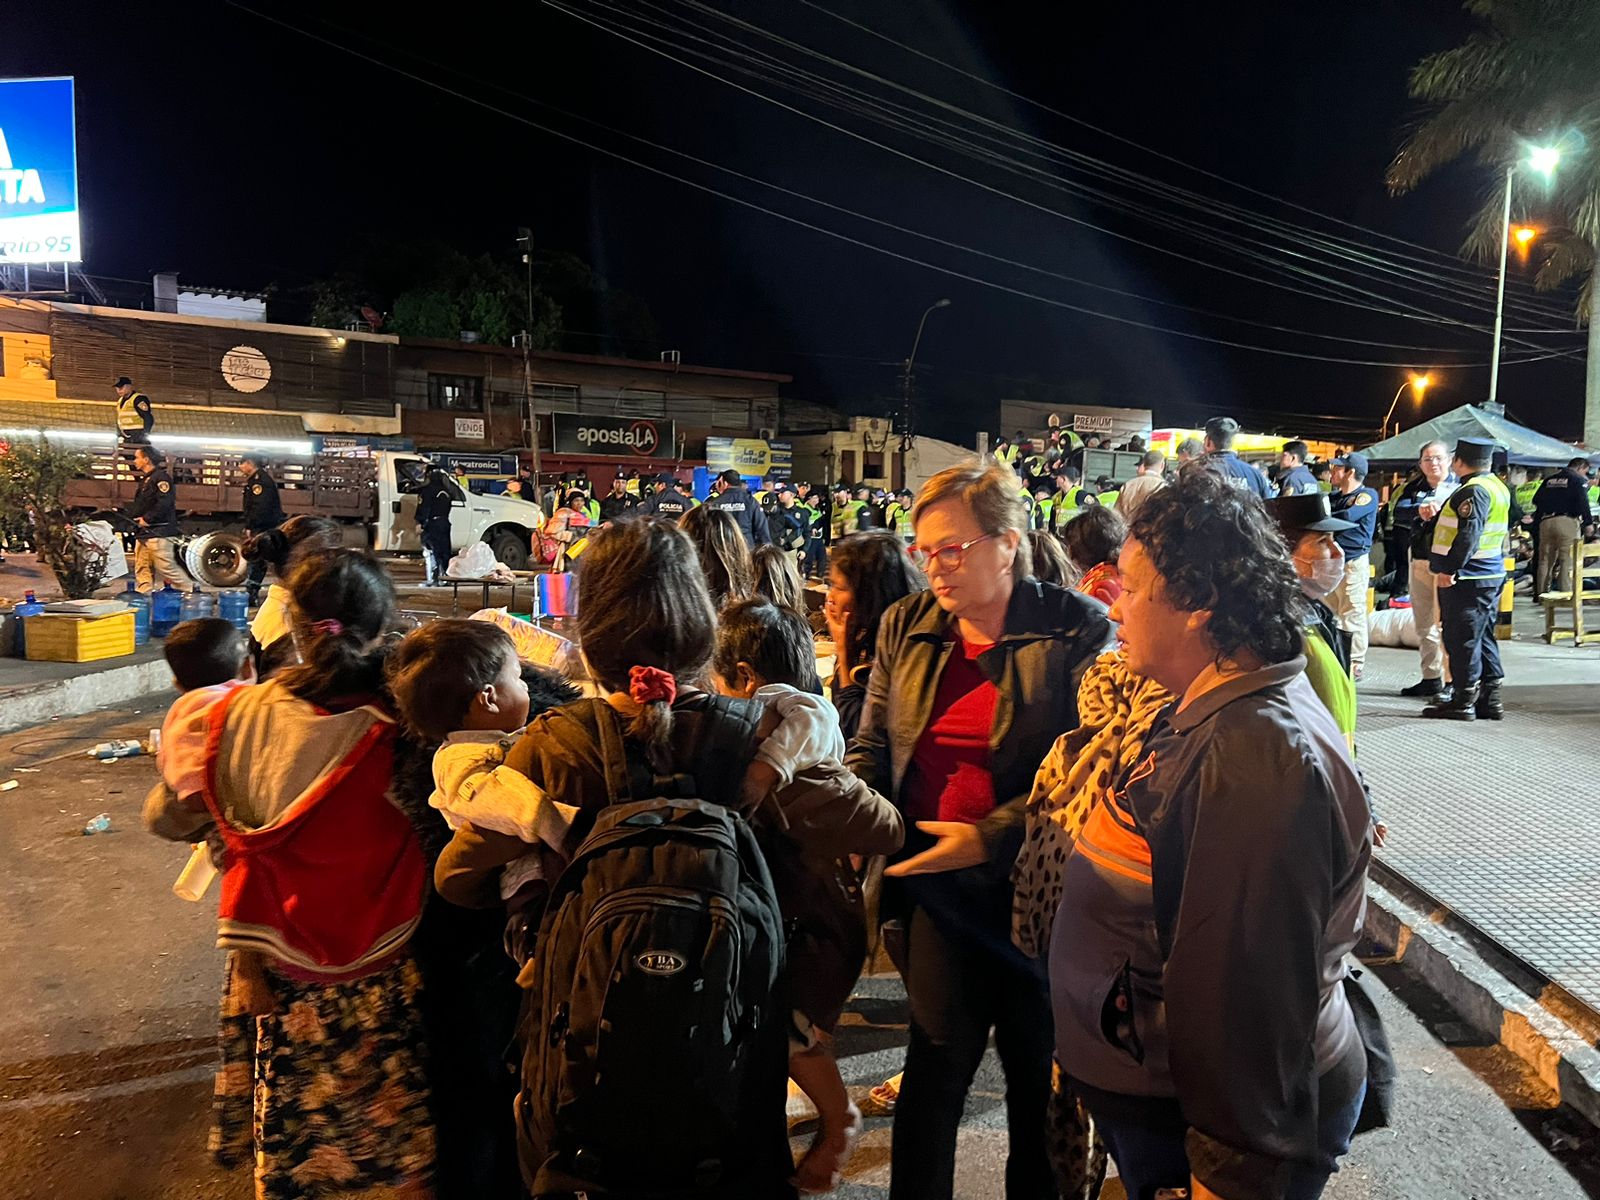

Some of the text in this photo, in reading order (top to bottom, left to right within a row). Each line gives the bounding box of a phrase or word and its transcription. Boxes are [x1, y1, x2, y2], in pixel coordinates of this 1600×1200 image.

[0, 168, 46, 204] TA
[45, 236, 72, 253] 95
[1076, 416, 1111, 427] PREMIUM
[456, 423, 483, 432] VENDE
[451, 459, 499, 469] Matronica
[658, 502, 683, 510] POLICIA
[720, 502, 745, 510] POLICIA
